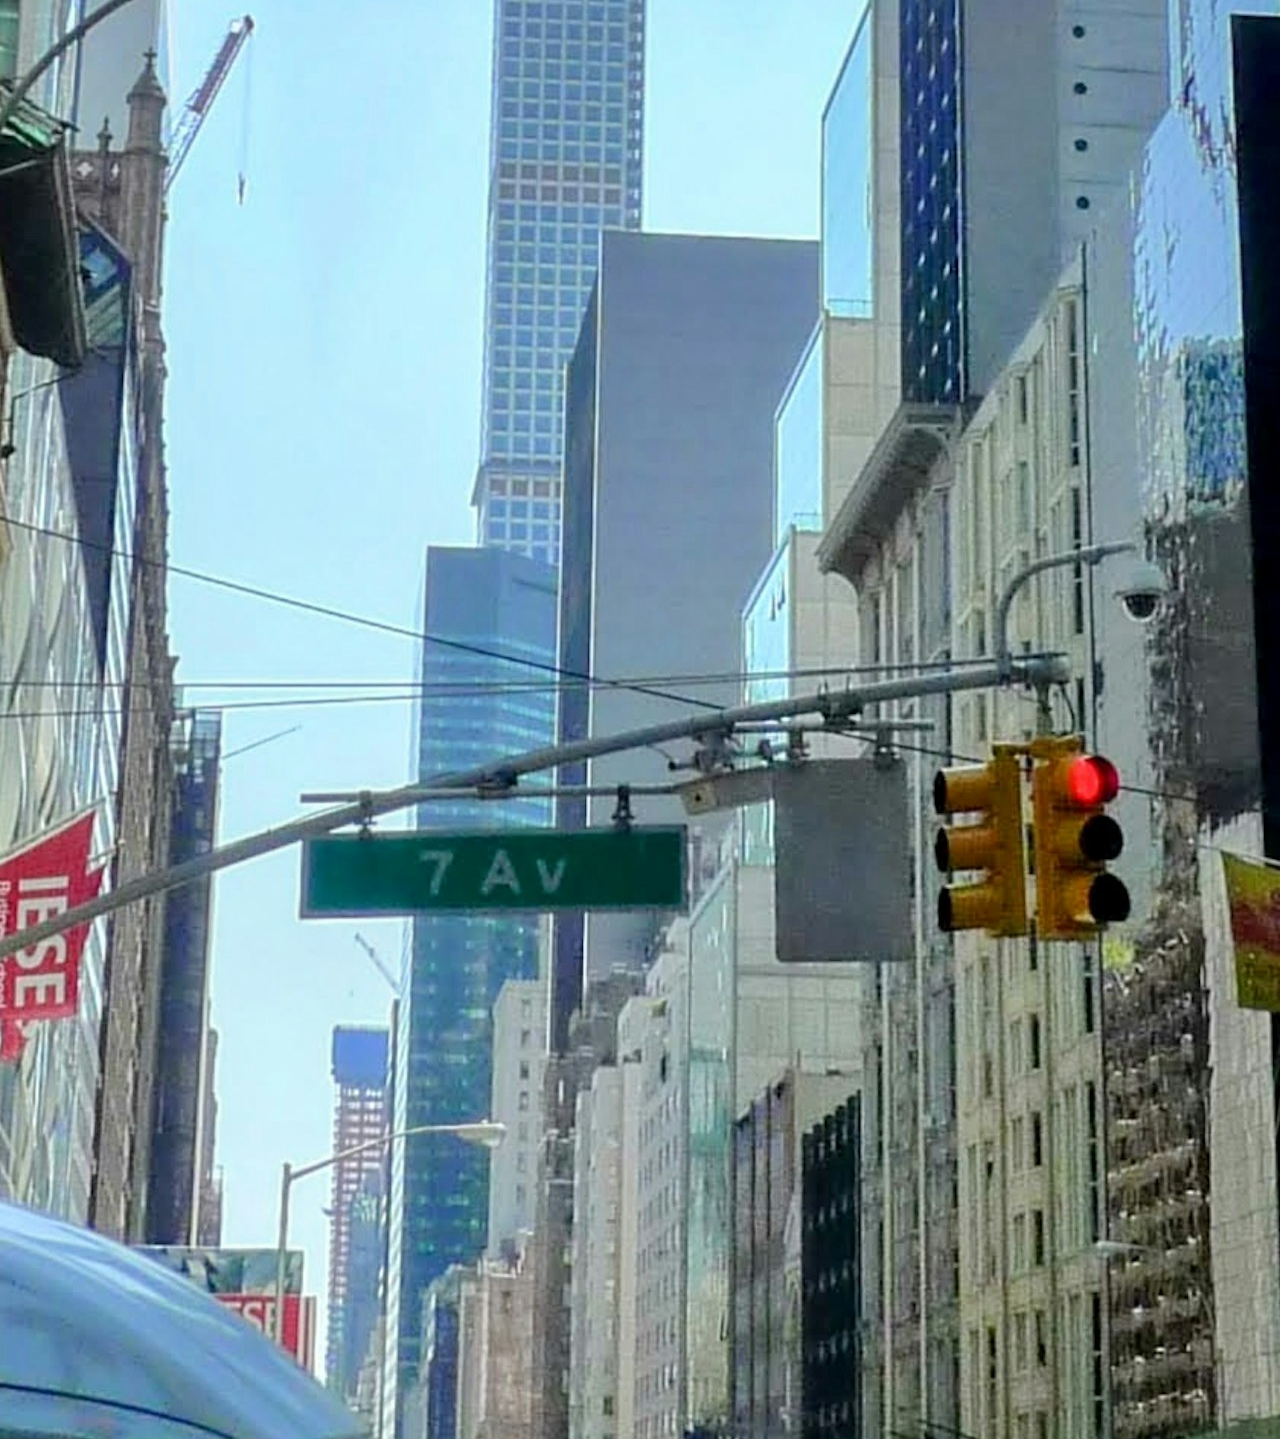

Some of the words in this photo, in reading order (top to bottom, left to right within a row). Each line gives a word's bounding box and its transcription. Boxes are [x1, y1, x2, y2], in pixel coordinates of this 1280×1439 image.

[421, 850, 454, 897] 7
[479, 848, 567, 896] Av
[14, 876, 69, 1007] IESE
